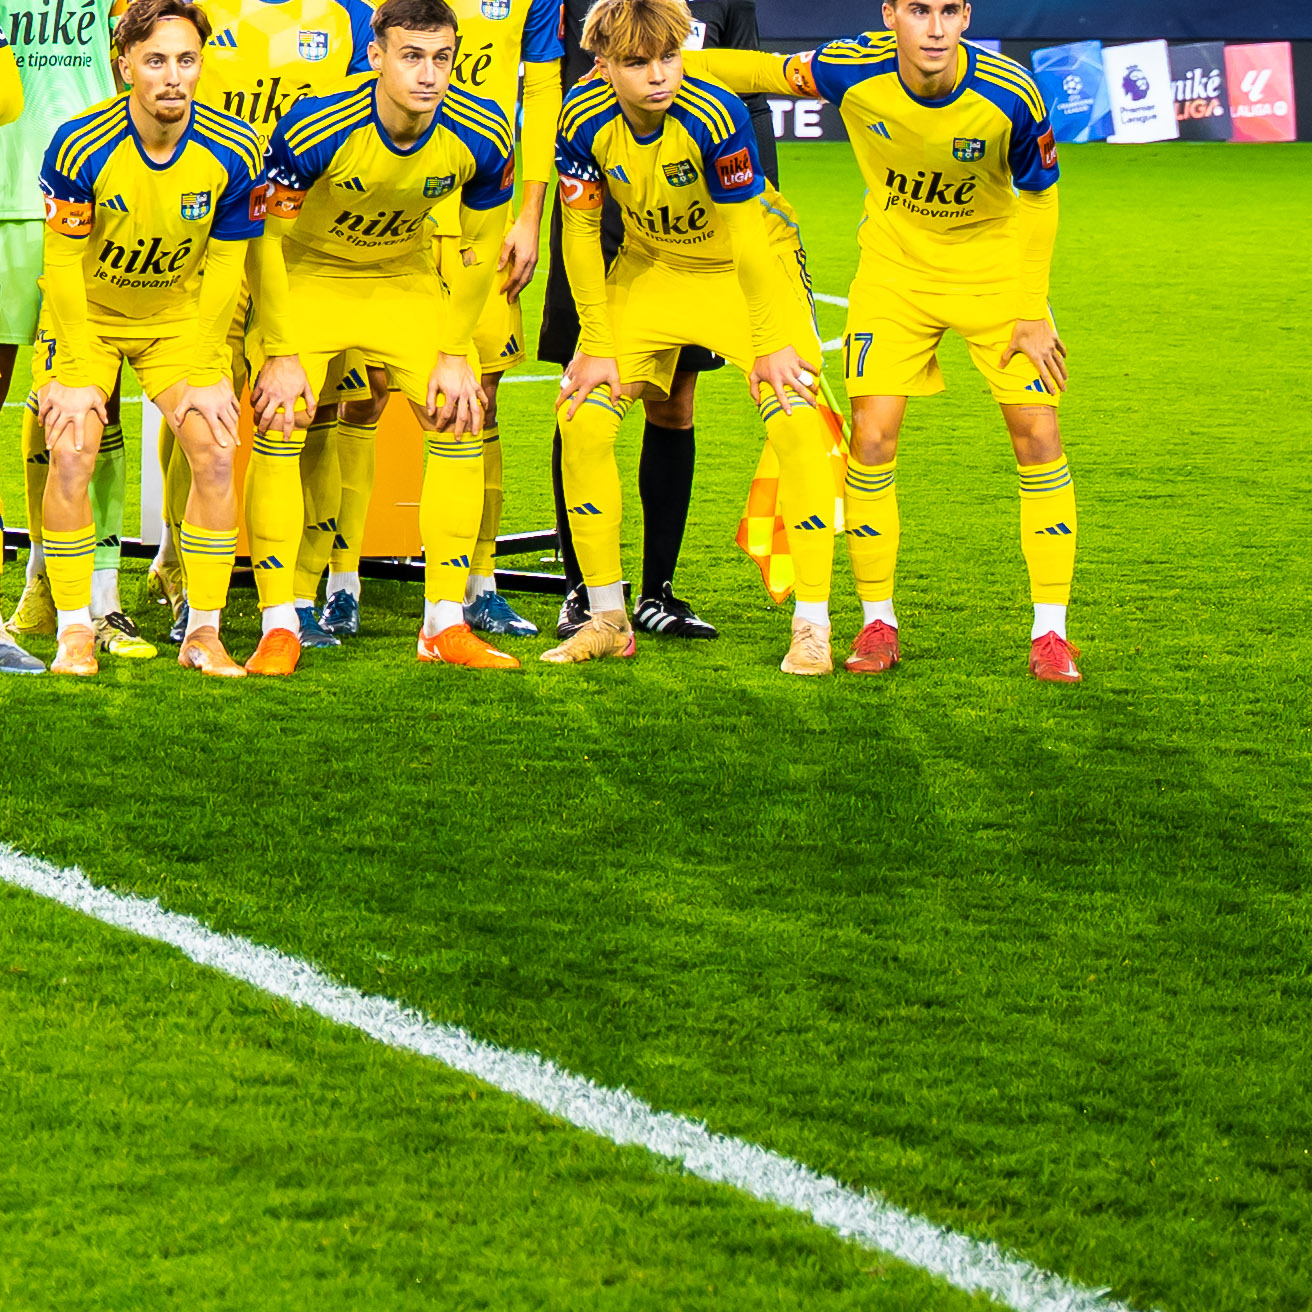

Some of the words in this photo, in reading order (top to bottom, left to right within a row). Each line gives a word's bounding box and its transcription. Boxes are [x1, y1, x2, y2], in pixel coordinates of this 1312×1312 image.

[28, 51, 92, 69] tipovanie
[719, 149, 750, 177] niké
[723, 170, 753, 187] LIGA
[885, 166, 976, 206] niké
[883, 192, 900, 211] je
[901, 198, 975, 219] tipovanie
[333, 206, 432, 238] niké
[327, 225, 345, 238] je
[346, 231, 417, 248] tipovanie
[98, 237, 193, 275] niké
[93, 266, 109, 280] je
[110, 272, 182, 289] tipovanie
[843, 332, 873, 379] 17
